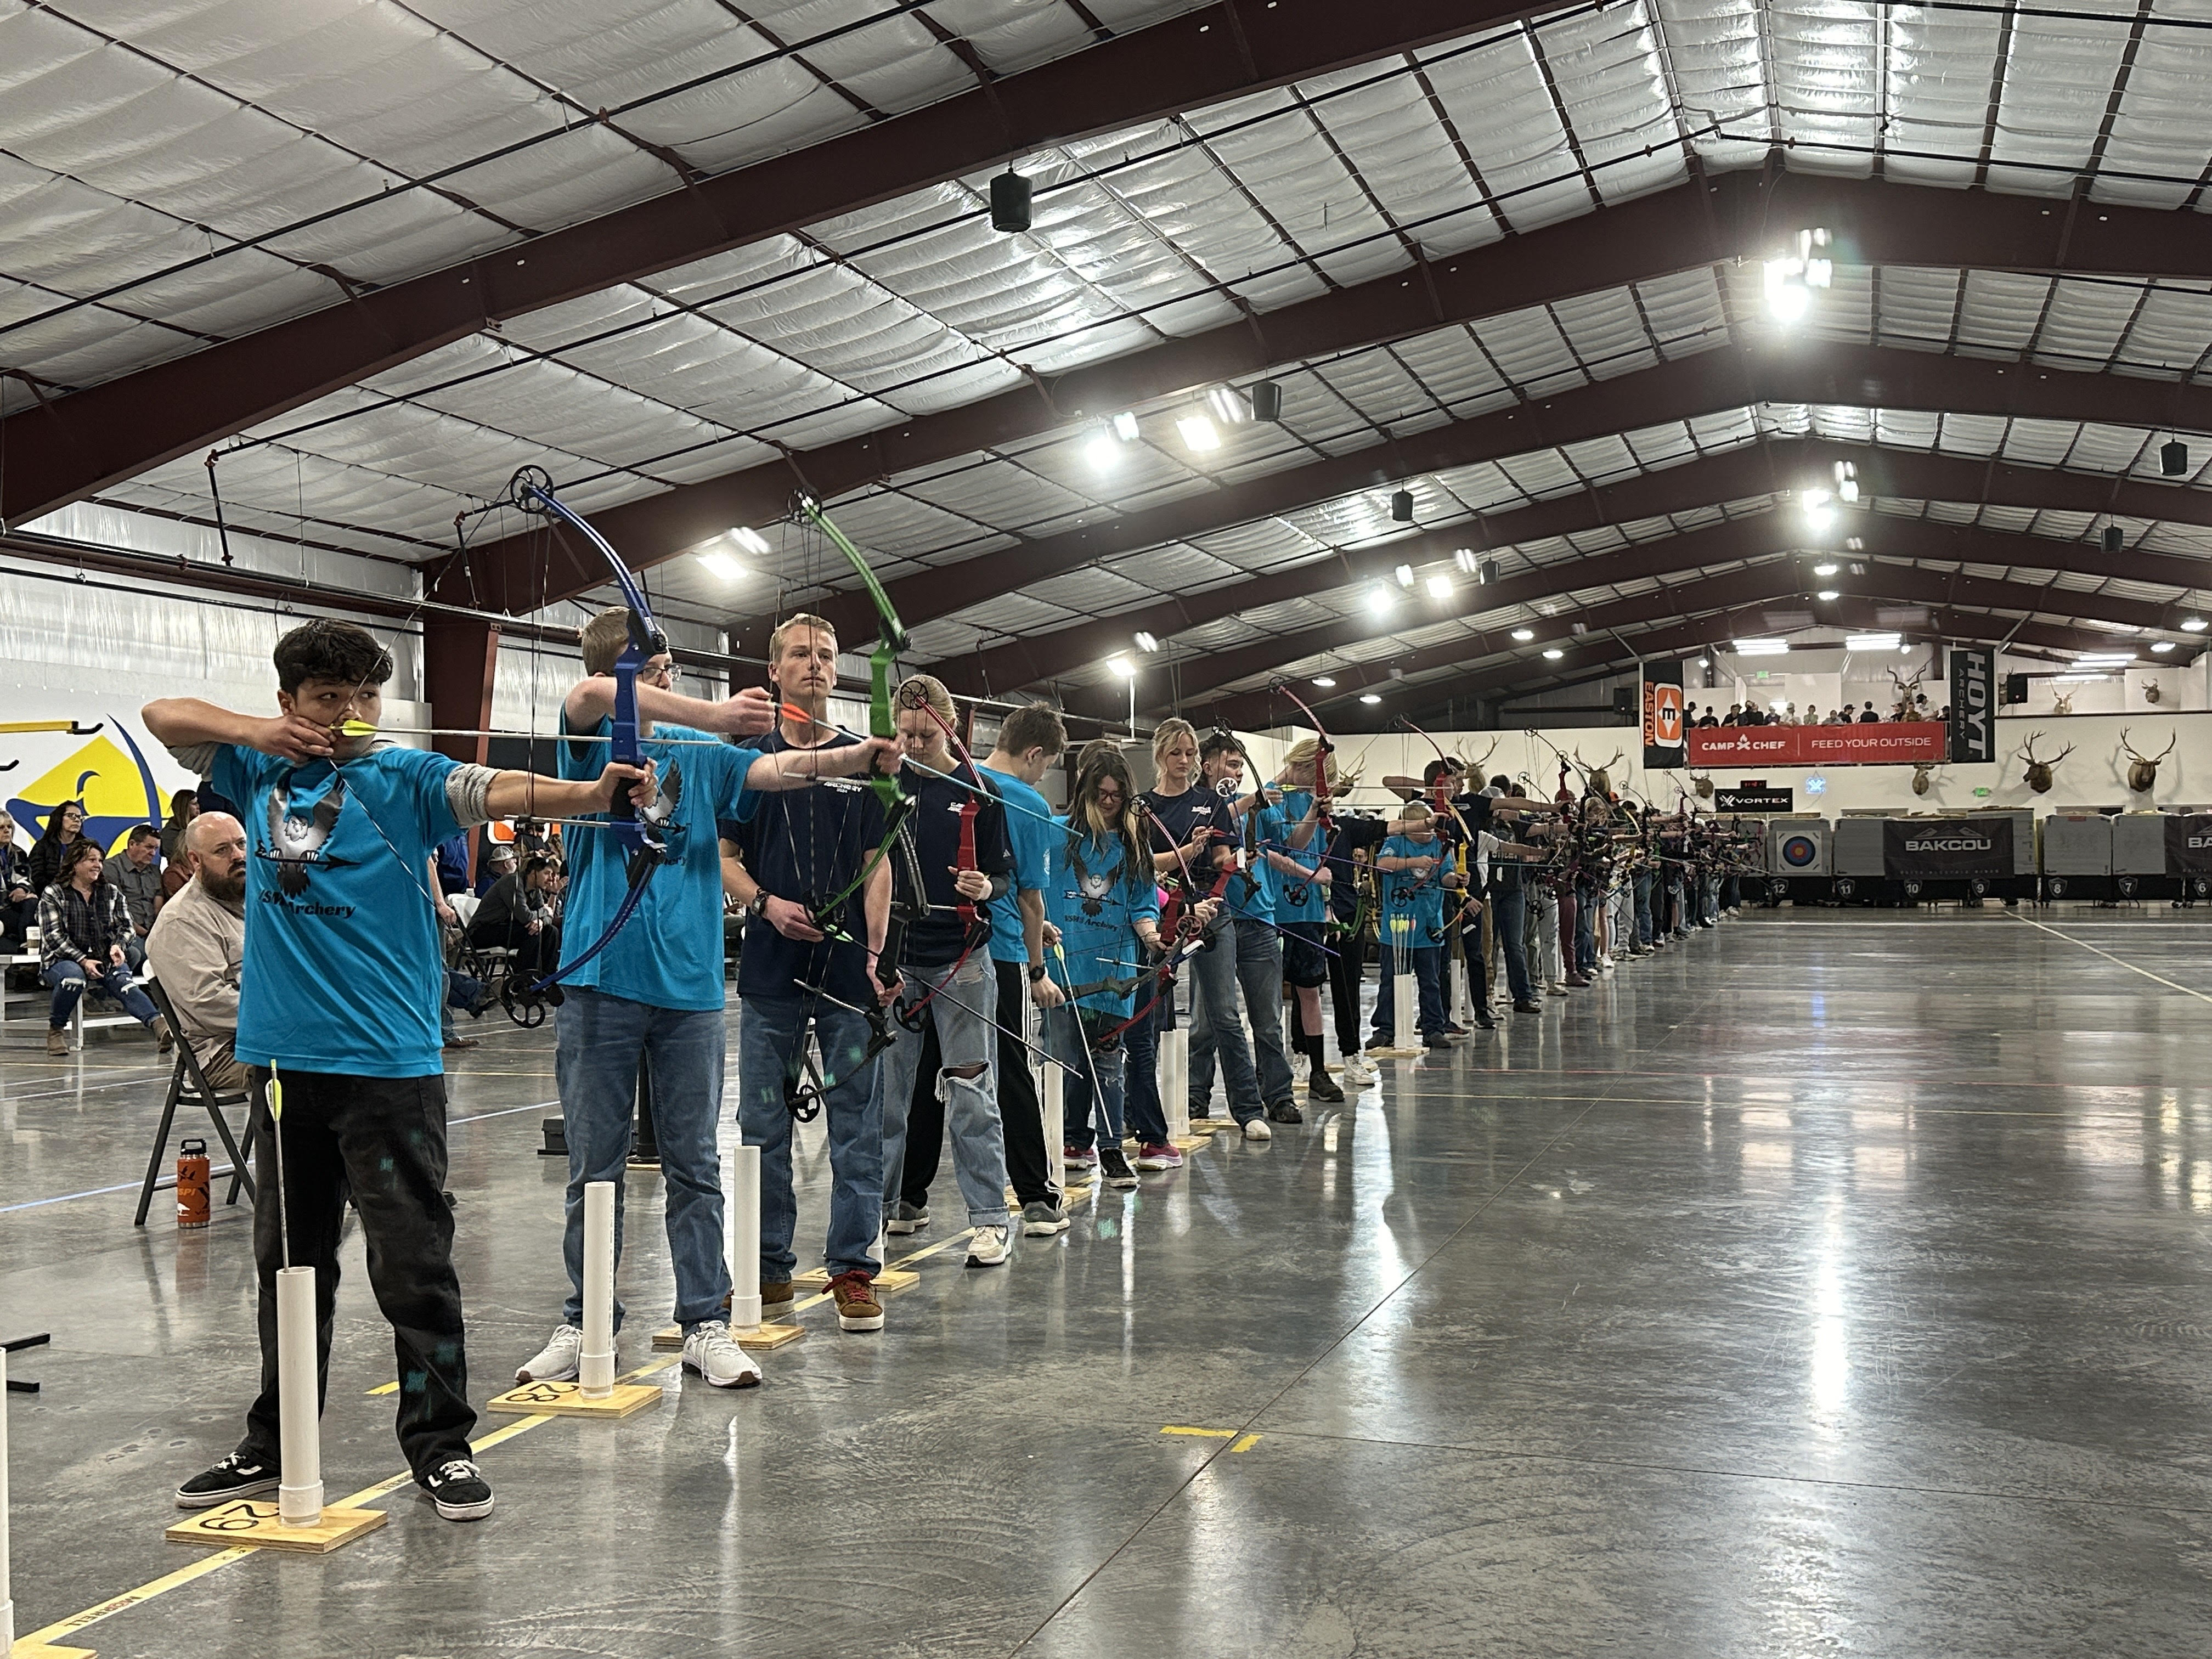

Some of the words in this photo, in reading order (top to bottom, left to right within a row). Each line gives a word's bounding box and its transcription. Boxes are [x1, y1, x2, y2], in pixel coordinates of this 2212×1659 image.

[1967, 652, 1986, 759] HOYT
[1645, 681, 1654, 747] EASTON
[1662, 707, 1675, 721] E
[1702, 742, 1735, 751] CAMP
[1753, 741, 1786, 749] CHEF
[1812, 740, 1843, 748] FEED
[1844, 738, 1877, 747] YOUR
[1880, 737, 1932, 747] OUTSIDE
[1905, 839, 1991, 851] BAKCOU
[1773, 884, 1786, 894] 12
[1841, 885, 1851, 894] 11
[1906, 884, 1919, 894] 10
[1976, 883, 1984, 893] 9
[2054, 884, 2061, 894] 8
[2125, 882, 2132, 893] 7
[2198, 883, 2206, 893] 6
[505, 1383, 579, 1402] 28
